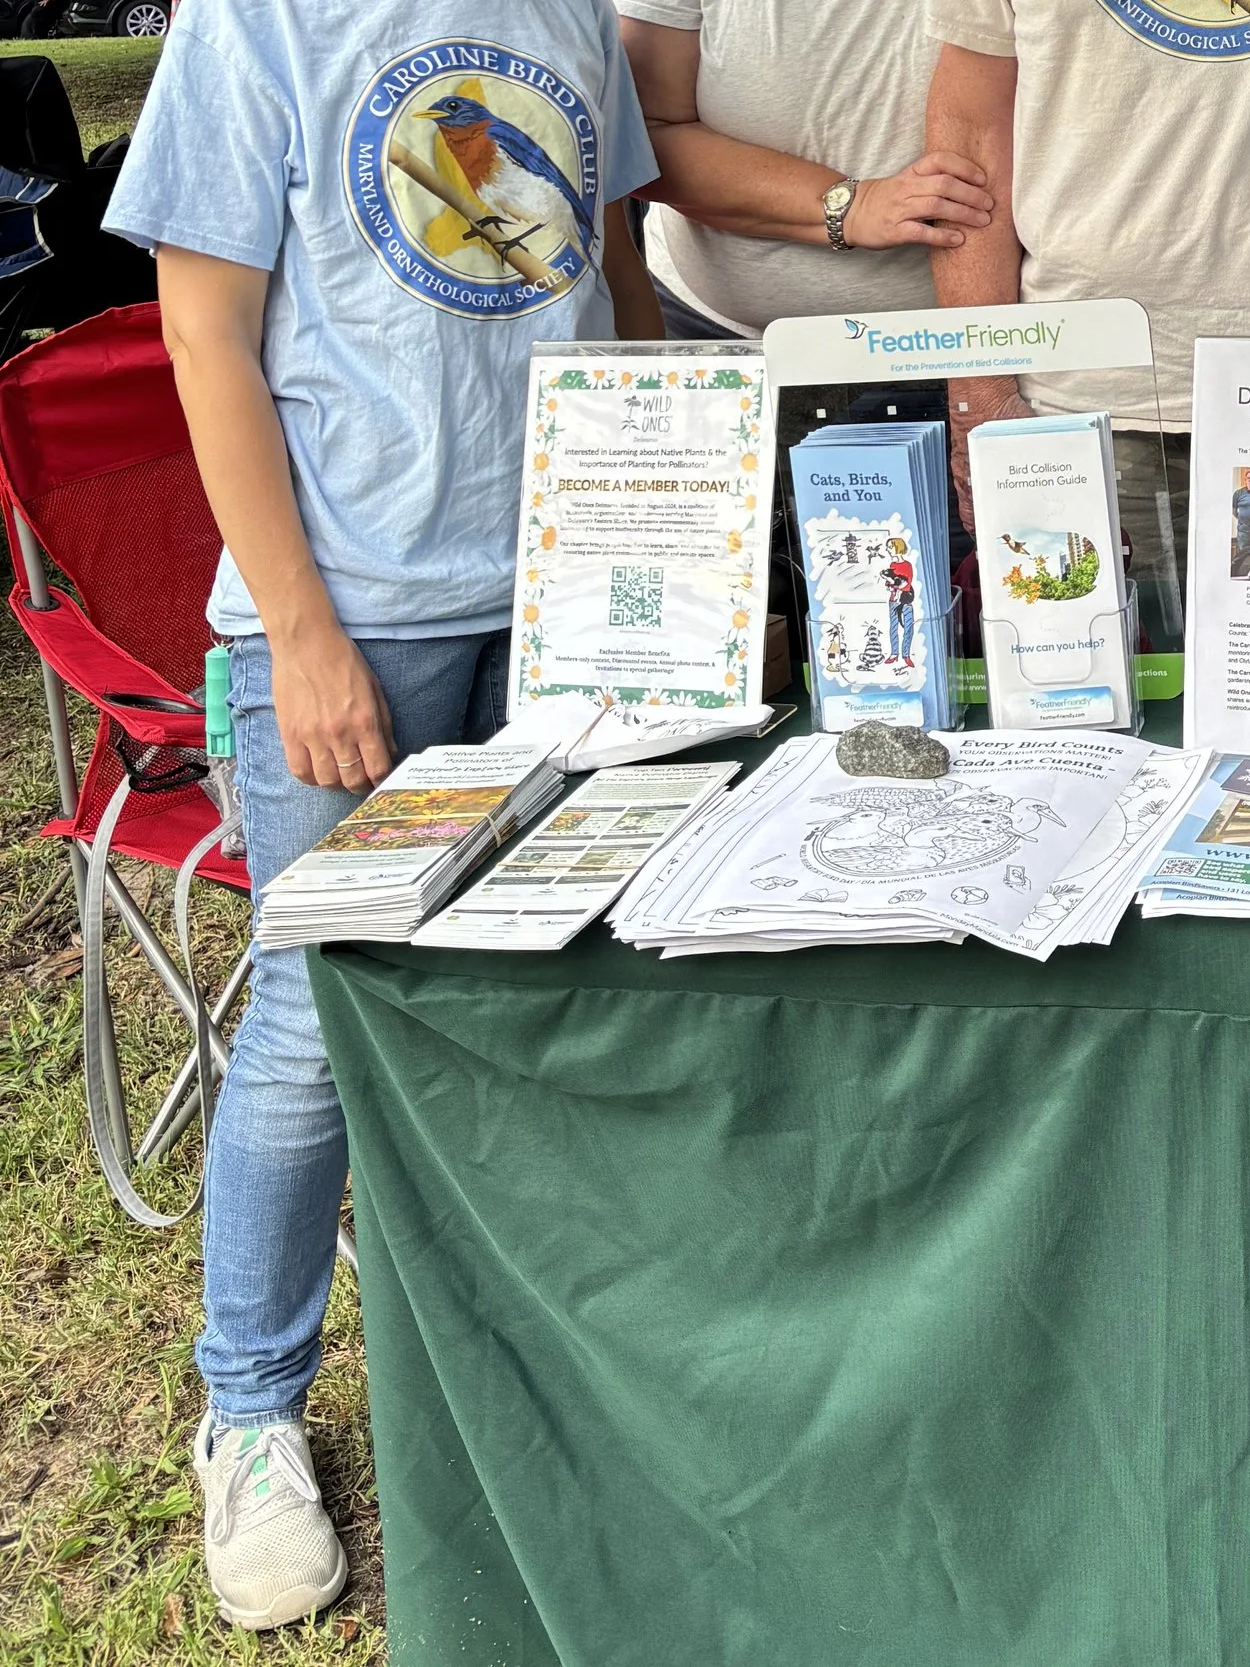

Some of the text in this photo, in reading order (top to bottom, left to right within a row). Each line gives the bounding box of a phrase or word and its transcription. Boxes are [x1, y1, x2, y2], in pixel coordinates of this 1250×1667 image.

[369, 46, 597, 194] CAROLINE BIRD CLUB
[360, 143, 576, 307] MARYLAND ORNITHOLOGICAL SOCIETY
[891, 356, 1032, 372] For the Prevention of Bird Collisions
[643, 395, 672, 413] WILD
[609, 448, 638, 457] Learning
[639, 448, 659, 456] about
[579, 460, 618, 468] Importance
[619, 460, 627, 468] of
[628, 460, 656, 469] Planting
[1009, 462, 1072, 475] Bird Collision
[558, 479, 730, 493] BECOME A MEMBER TODAY!
[810, 474, 892, 487] Cats, Birds,
[997, 474, 1087, 490] Information Guide
[824, 489, 883, 502] and You
[1011, 638, 1105, 655] How can you help?
[1036, 698, 1092, 709] FeatherFriendly
[960, 740, 1124, 755] Every Bird Counts
[953, 757, 1103, 771] Cada Ave Cuenta
